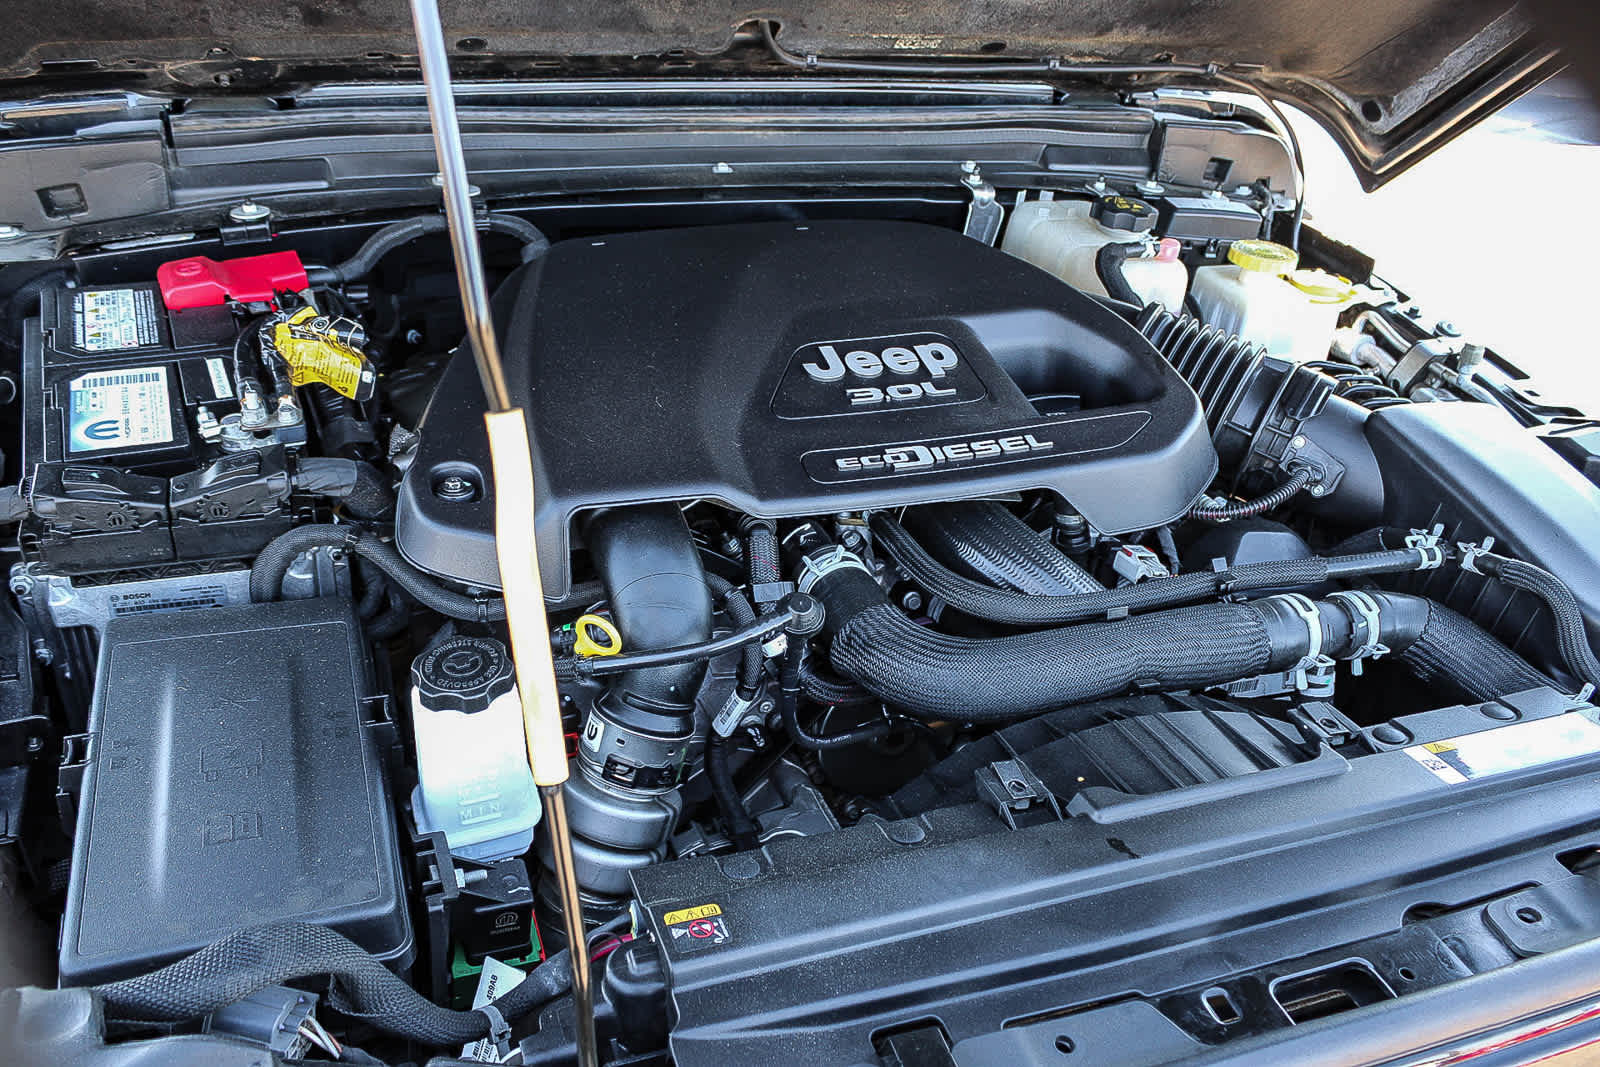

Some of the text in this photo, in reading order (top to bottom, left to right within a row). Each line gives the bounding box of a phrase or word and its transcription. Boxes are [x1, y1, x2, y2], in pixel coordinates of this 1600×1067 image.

[803, 342, 958, 382] Jeep
[846, 381, 957, 406] 3.0L
[123, 592, 152, 600] BOSCH
